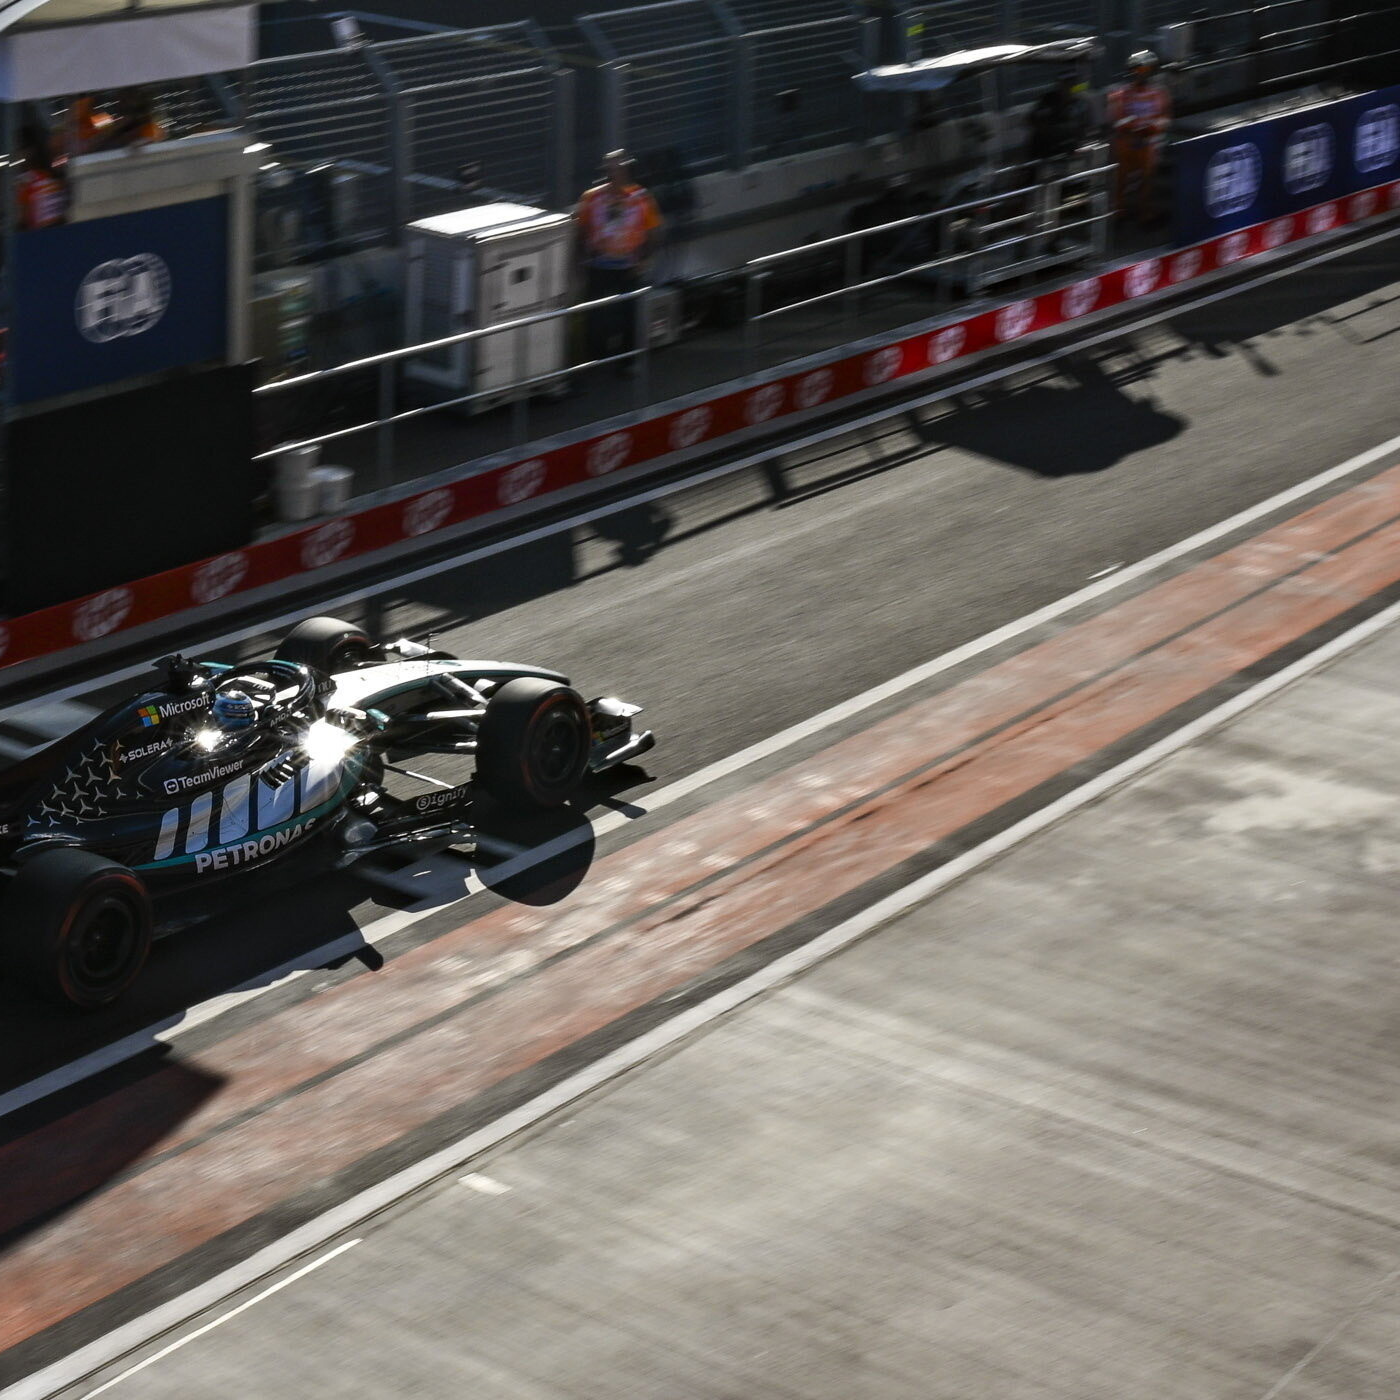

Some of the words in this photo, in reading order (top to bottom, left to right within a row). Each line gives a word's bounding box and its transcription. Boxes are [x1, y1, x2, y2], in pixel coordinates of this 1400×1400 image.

[80, 267, 168, 335] FIA
[159, 694, 211, 719] Microsoft
[128, 741, 168, 762] SOLERA
[178, 760, 244, 790] TeamViewer
